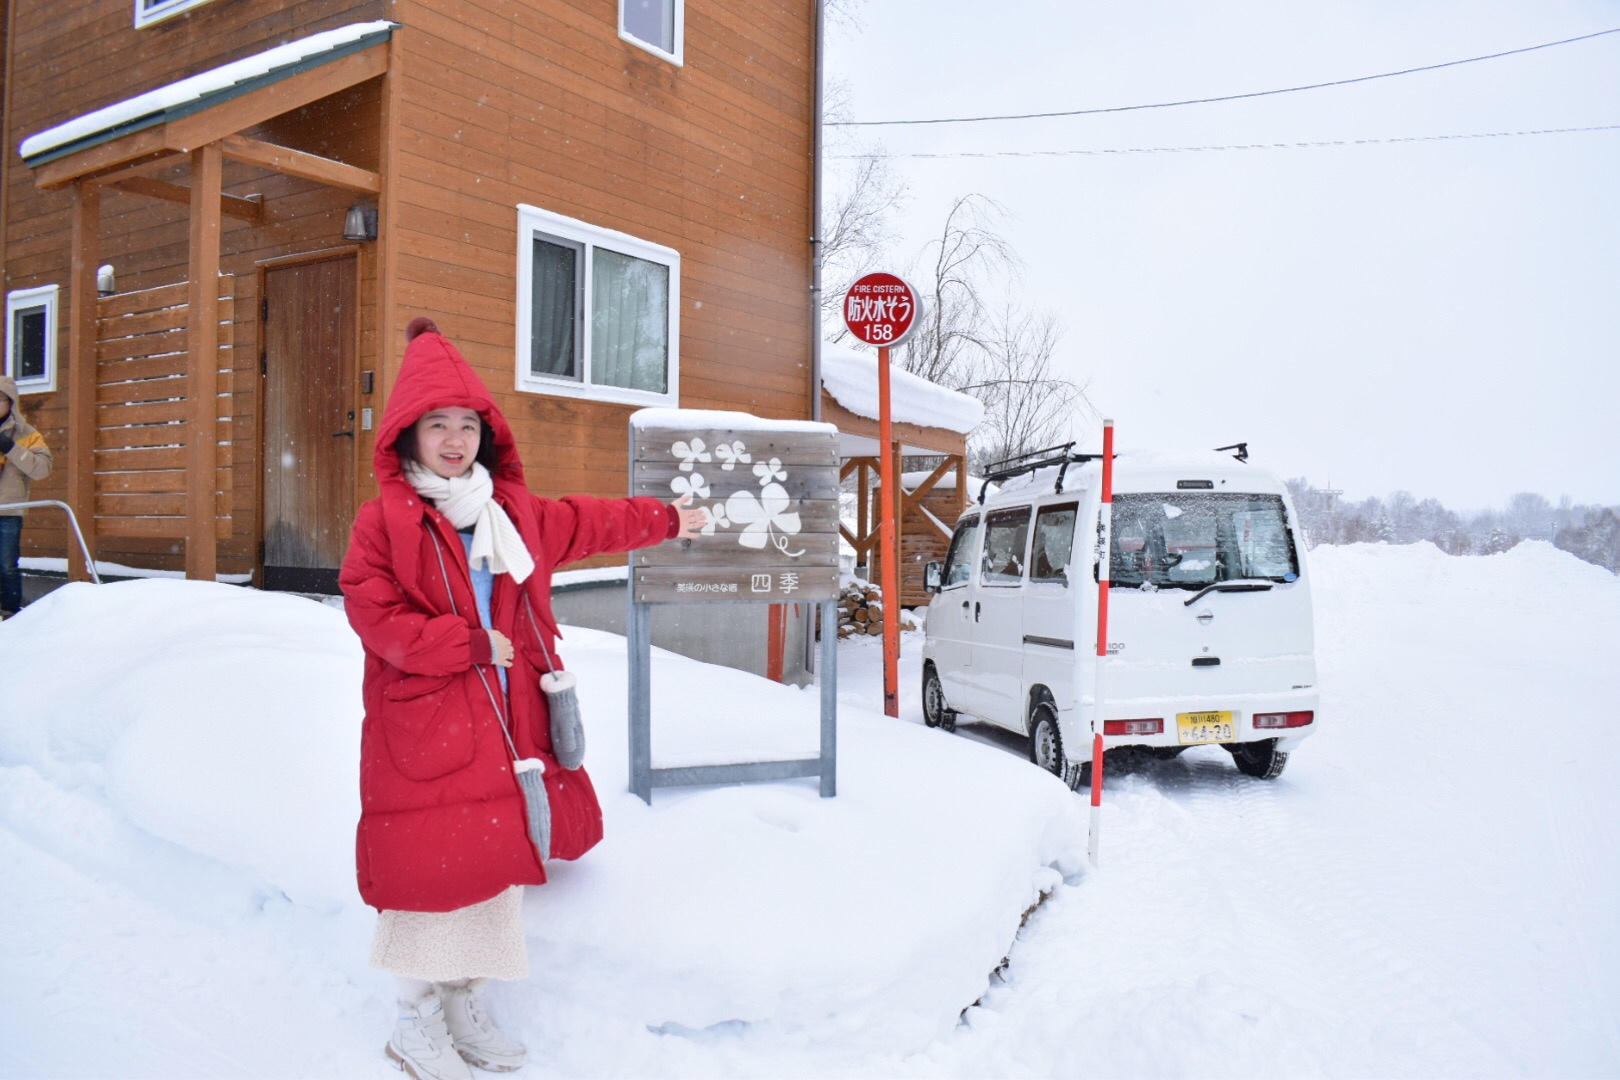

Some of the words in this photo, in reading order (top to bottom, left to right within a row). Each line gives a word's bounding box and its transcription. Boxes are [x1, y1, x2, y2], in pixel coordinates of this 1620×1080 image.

[854, 285, 871, 293] FIRE
[873, 285, 905, 293] CISTERN
[847, 295, 912, 322] 防火水そう
[864, 324, 893, 341] 158
[676, 583, 738, 593] 美瑛の小さな宿
[751, 572, 799, 594] 四季
